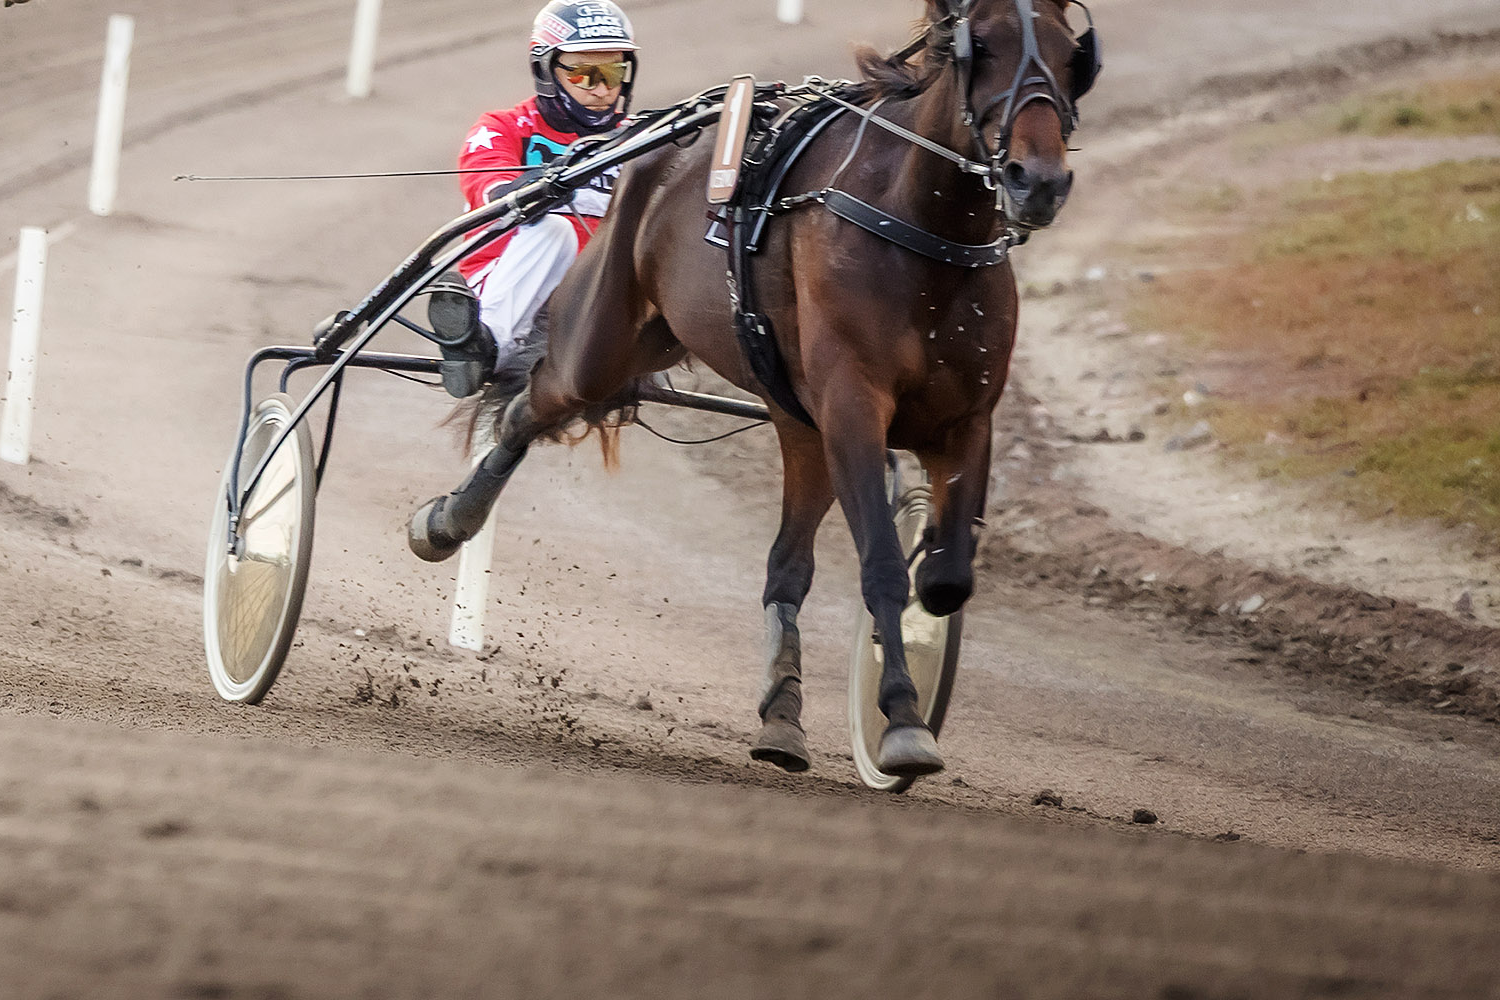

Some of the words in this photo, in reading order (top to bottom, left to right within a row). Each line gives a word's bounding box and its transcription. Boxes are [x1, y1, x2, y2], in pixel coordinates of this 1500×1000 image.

[577, 15, 622, 28] BLACK
[578, 26, 625, 39] HORSE
[722, 83, 746, 165] 1
